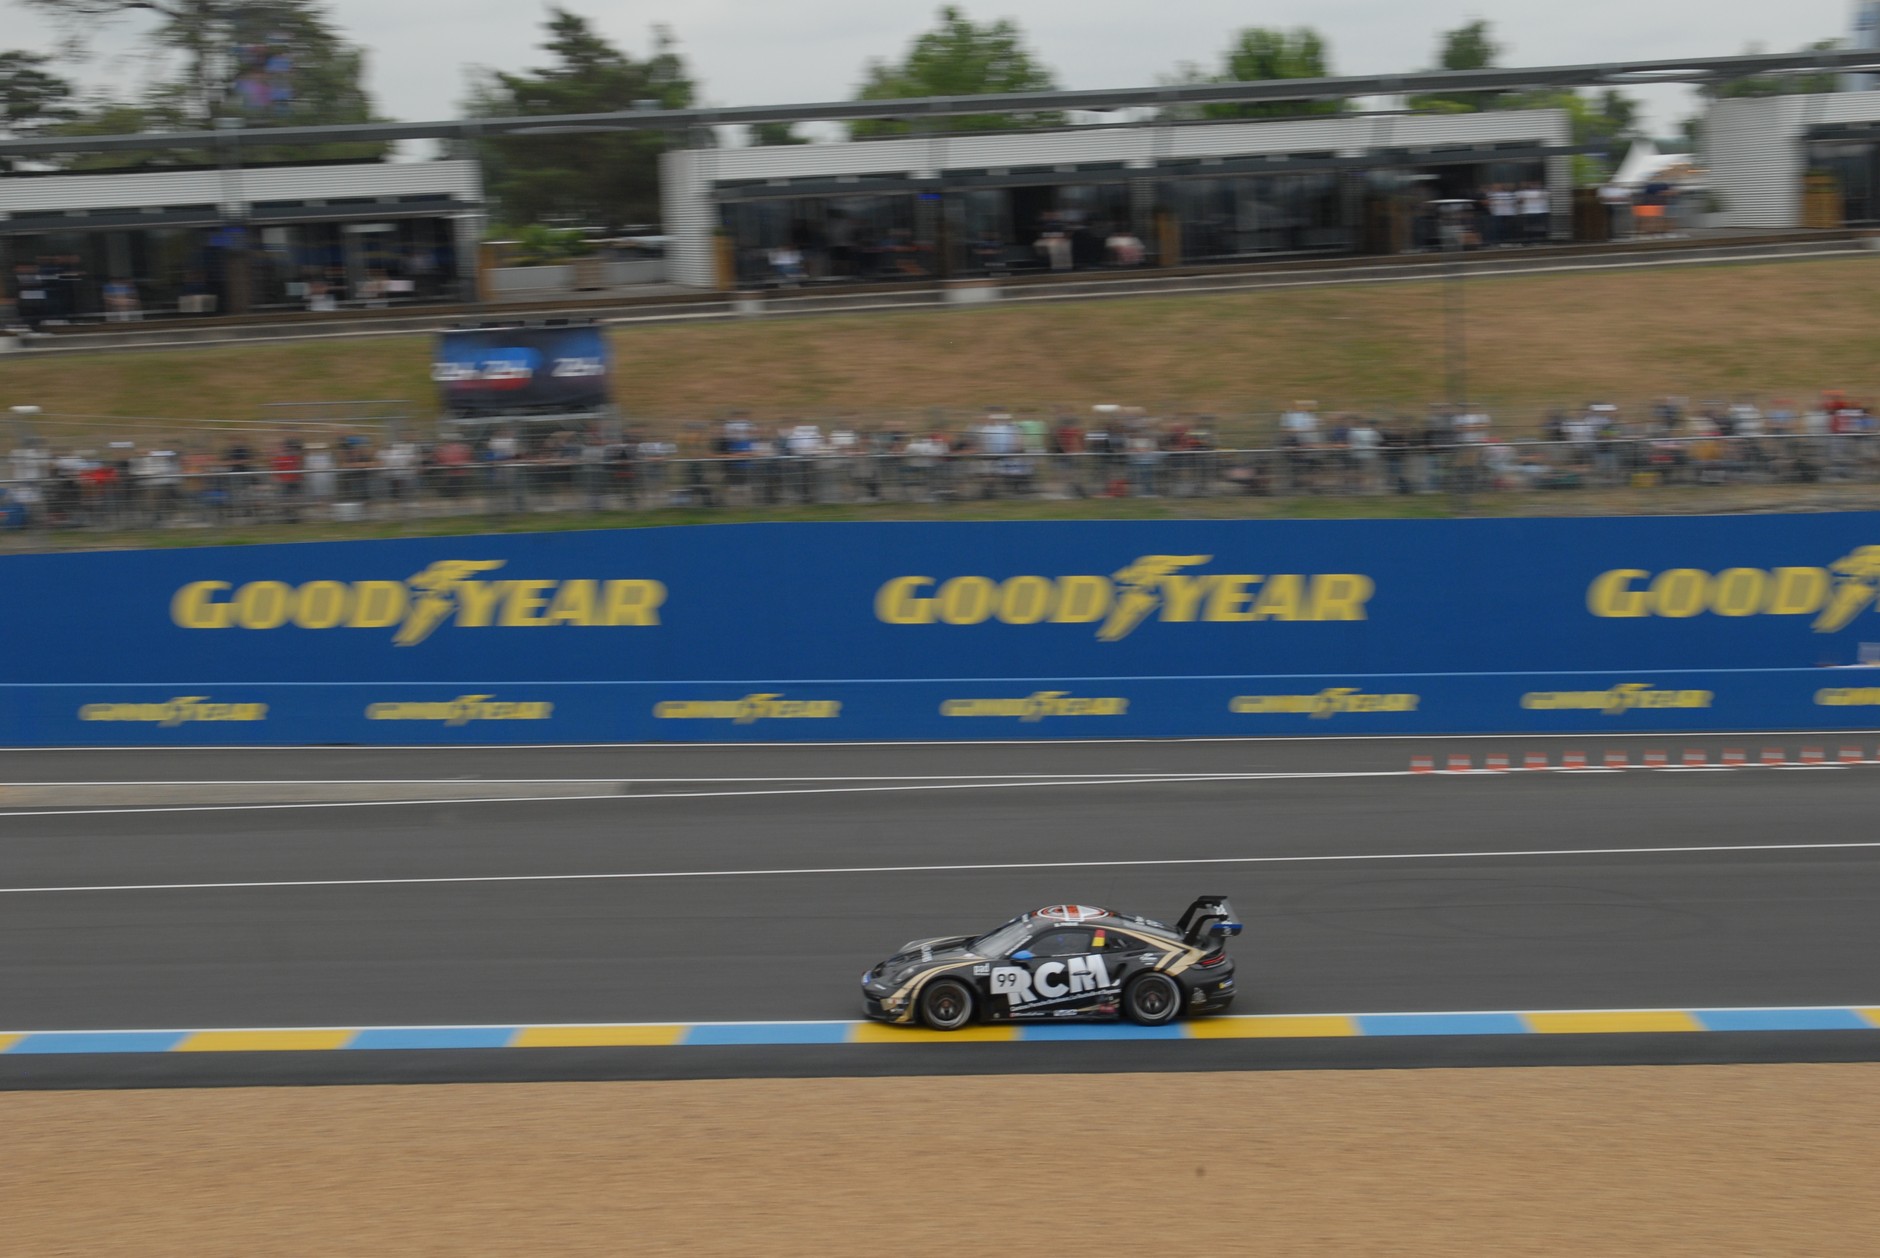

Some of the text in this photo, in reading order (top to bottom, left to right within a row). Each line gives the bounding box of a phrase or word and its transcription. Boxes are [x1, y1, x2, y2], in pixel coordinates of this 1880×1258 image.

[172, 570, 666, 639] GOODYEAR
[876, 566, 1373, 635] GOODYEAR
[1588, 556, 1880, 627] GOOD
[997, 973, 1017, 987] 99
[1001, 954, 1110, 1005] RCM
